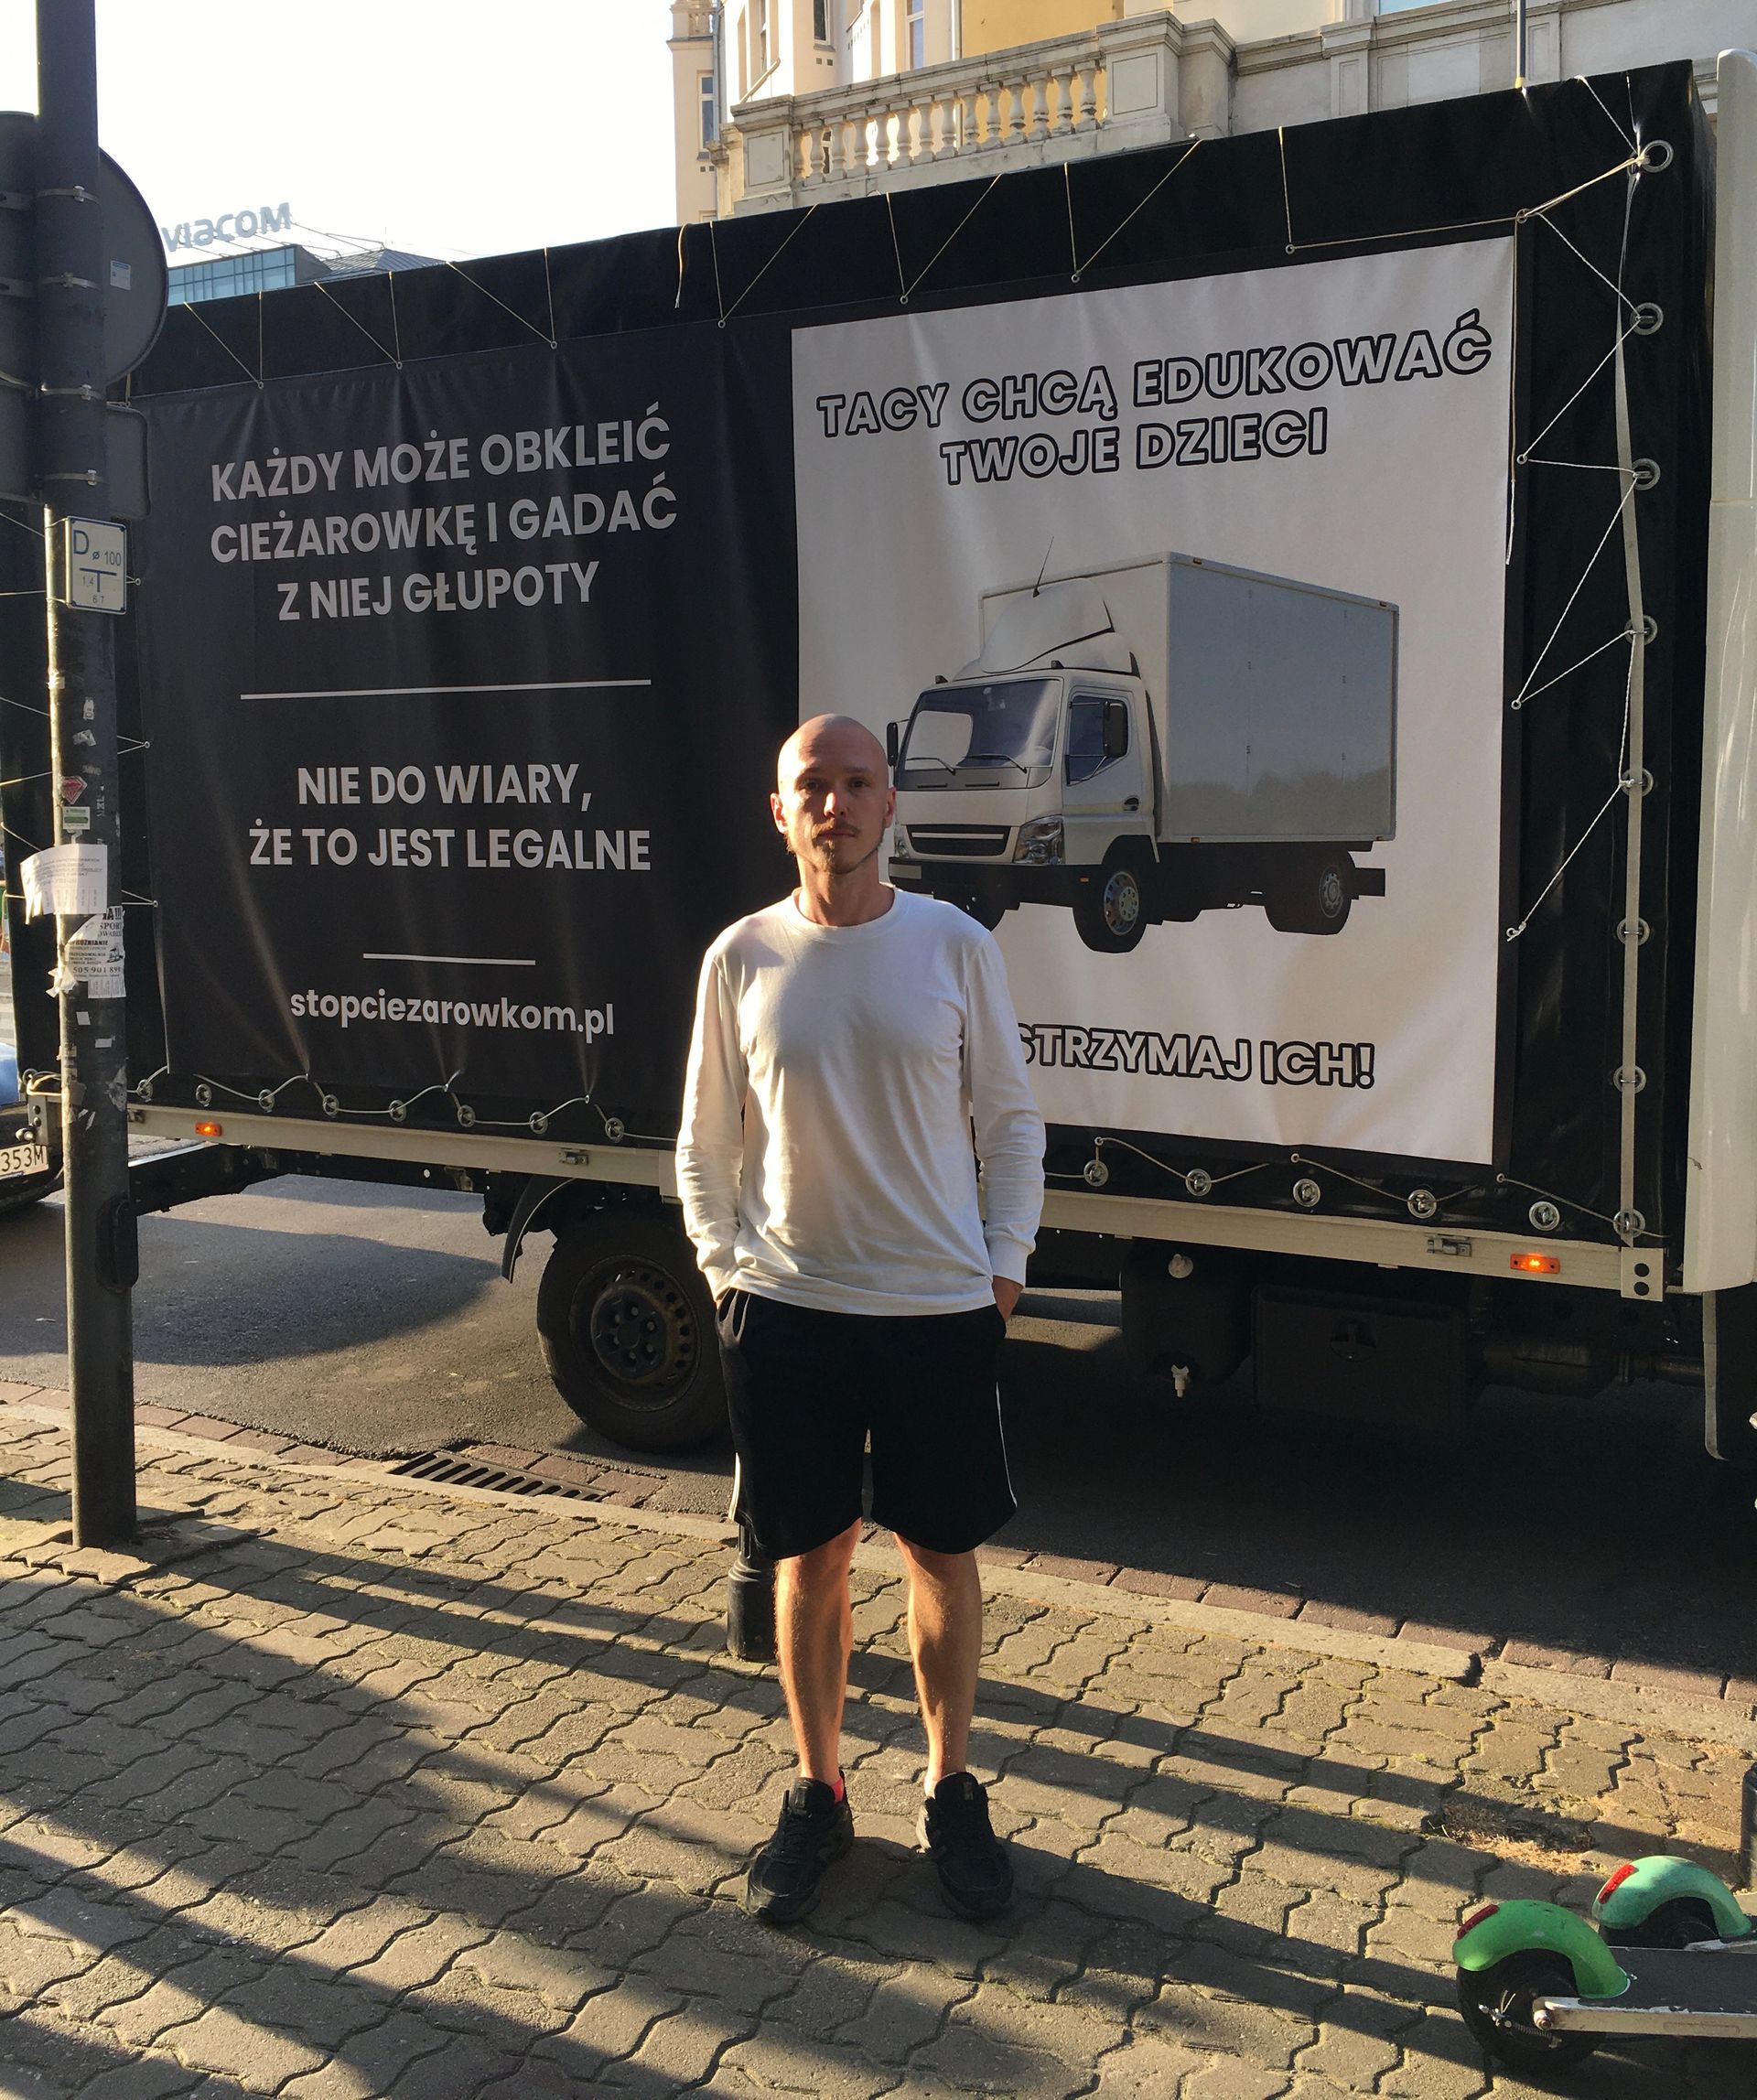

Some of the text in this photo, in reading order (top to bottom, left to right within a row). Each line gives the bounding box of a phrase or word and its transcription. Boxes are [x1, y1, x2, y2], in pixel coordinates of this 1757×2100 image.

[815, 307, 1493, 438] TACY CHCĄ EDUKOWAĆ
[210, 401, 671, 502] KAŻDY MOŻE OBKLEIĆ
[939, 406, 1328, 486] TWOJE DZIECI
[210, 470, 677, 564] CIEŻAROWKĘ I GADAĆ
[104, 551, 122, 566] 100
[277, 560, 600, 621] Z NIEJ GŁUPOTY
[297, 763, 592, 812] NIE DO WIARY,
[249, 818, 652, 871] ŻE TO JEST LEGALNE
[289, 987, 615, 1044] stopciezarowkom.pl
[1259, 1039, 1375, 1090] ICH!
